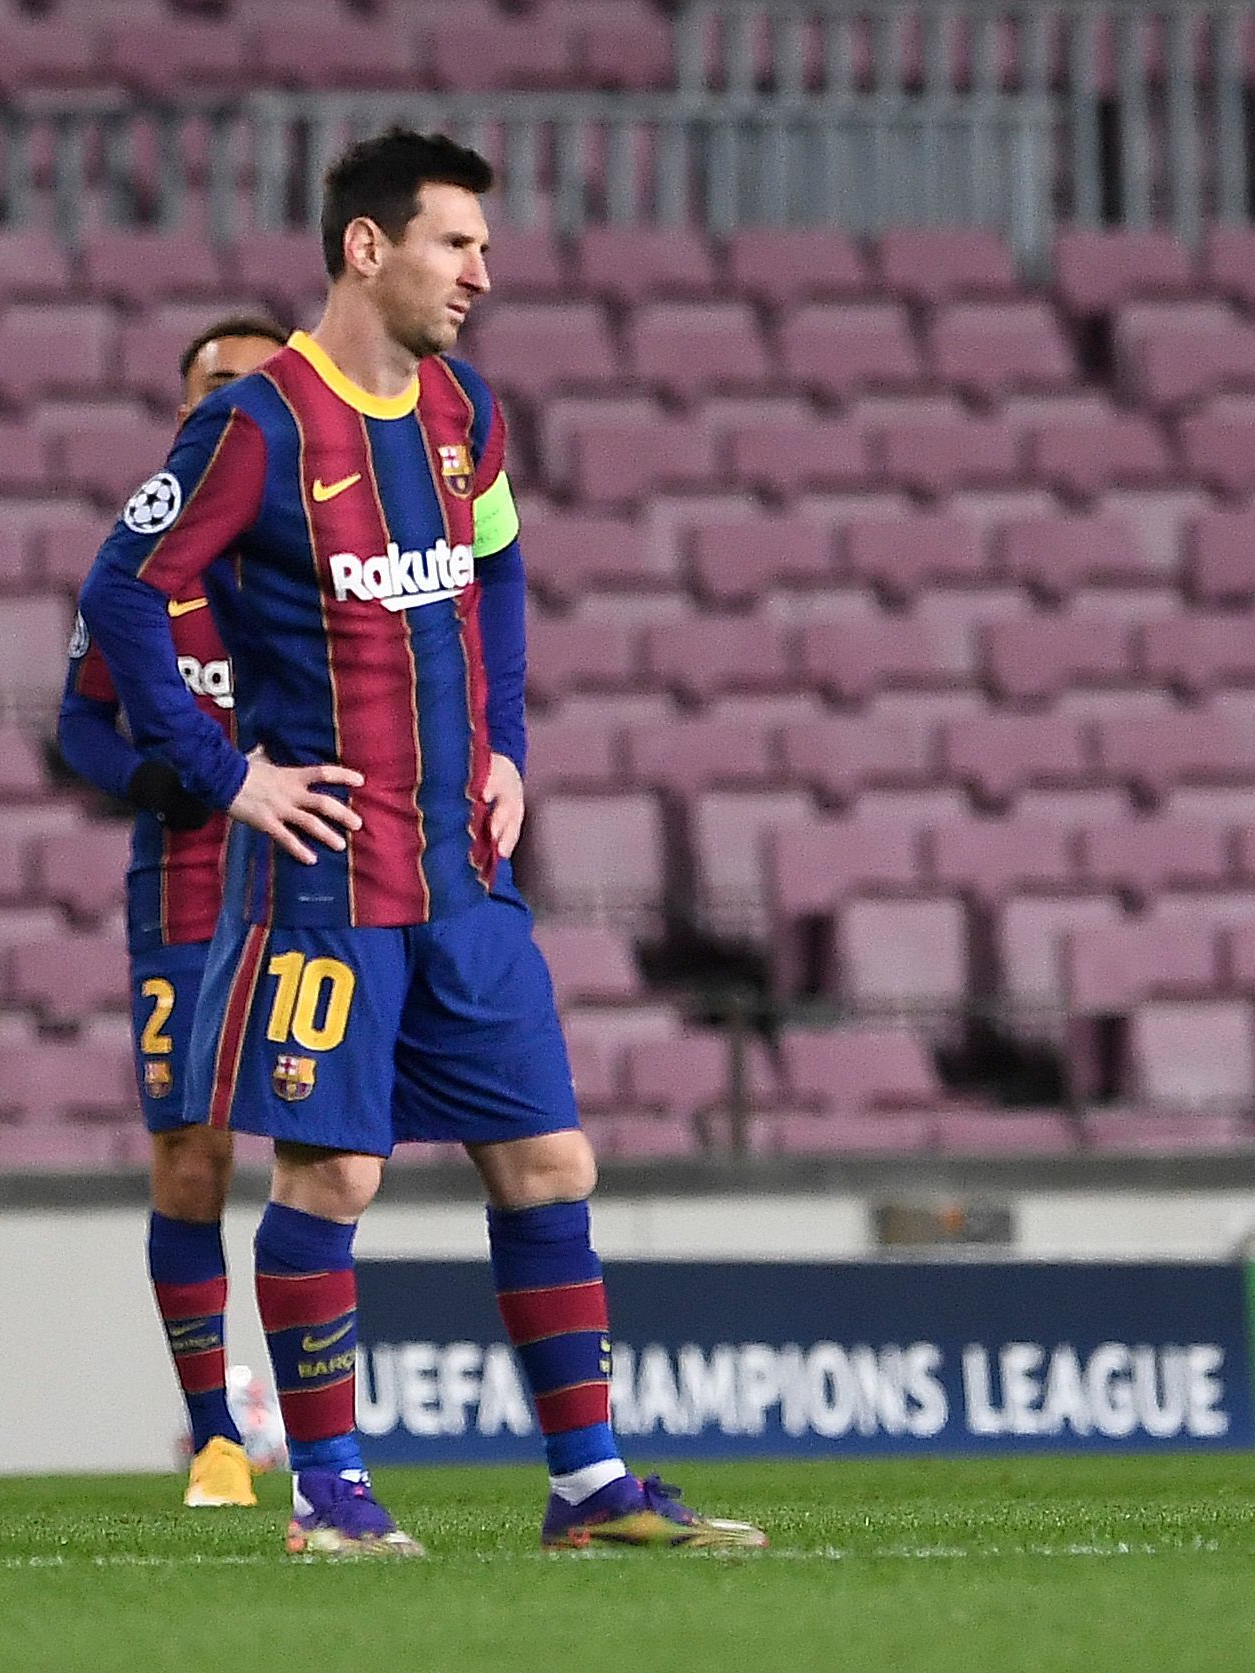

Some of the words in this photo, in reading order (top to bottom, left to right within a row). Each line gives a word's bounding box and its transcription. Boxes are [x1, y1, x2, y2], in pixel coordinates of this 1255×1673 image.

[141, 977, 176, 1055] 2
[266, 950, 357, 1052] 10
[354, 1341, 533, 1436] UEFA
[612, 1340, 949, 1438] HAMPIONS
[961, 1341, 1229, 1438] LEAGUE
